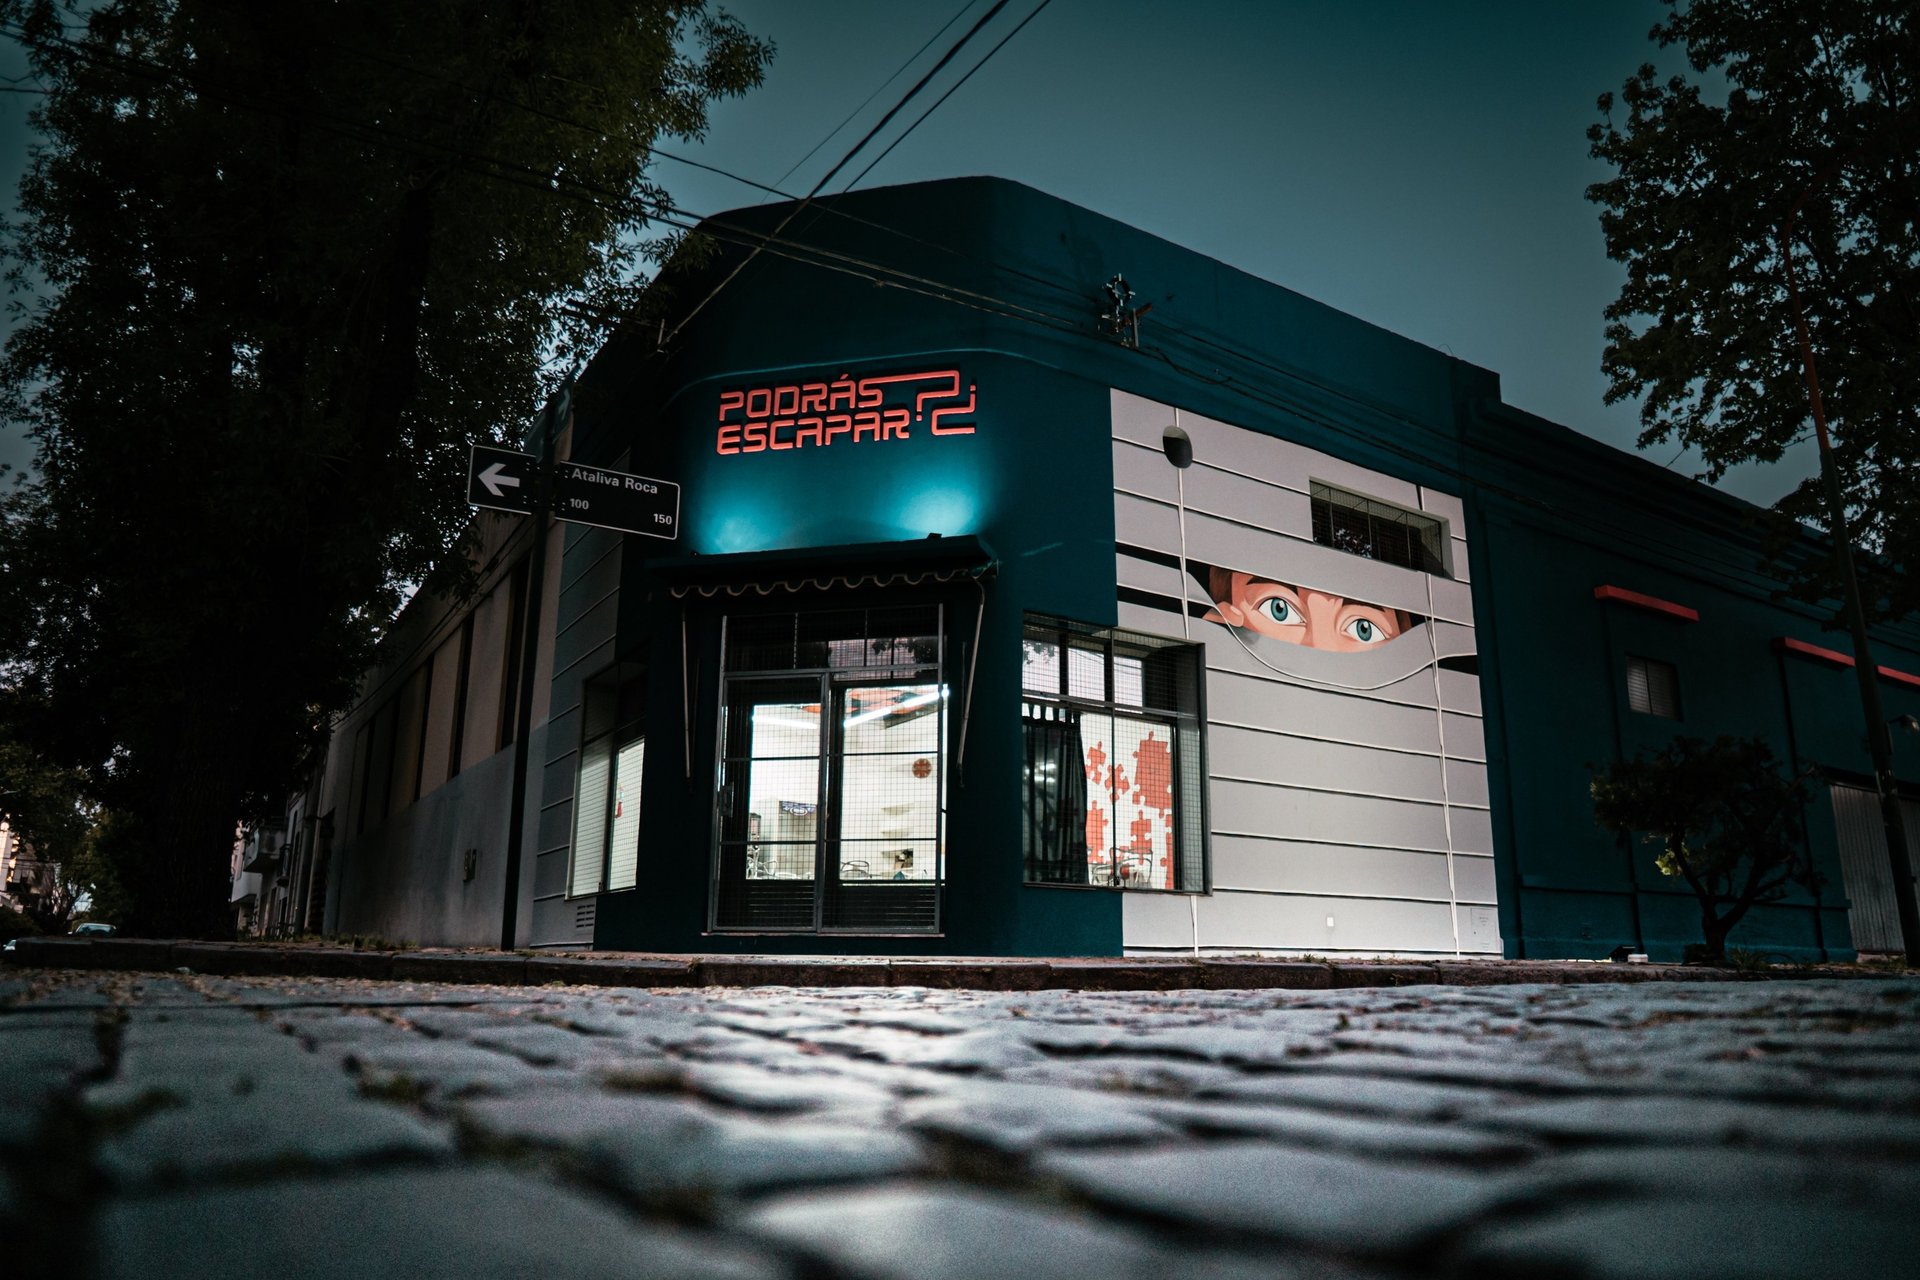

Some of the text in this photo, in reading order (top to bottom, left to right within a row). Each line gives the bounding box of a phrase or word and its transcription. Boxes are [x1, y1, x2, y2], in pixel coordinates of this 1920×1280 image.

[719, 373, 883, 422] PODRÁS
[716, 408, 910, 456] ESCAPAR
[571, 467, 659, 494] Ataliva Roca
[569, 498, 590, 510] 100
[652, 513, 673, 526] 150
